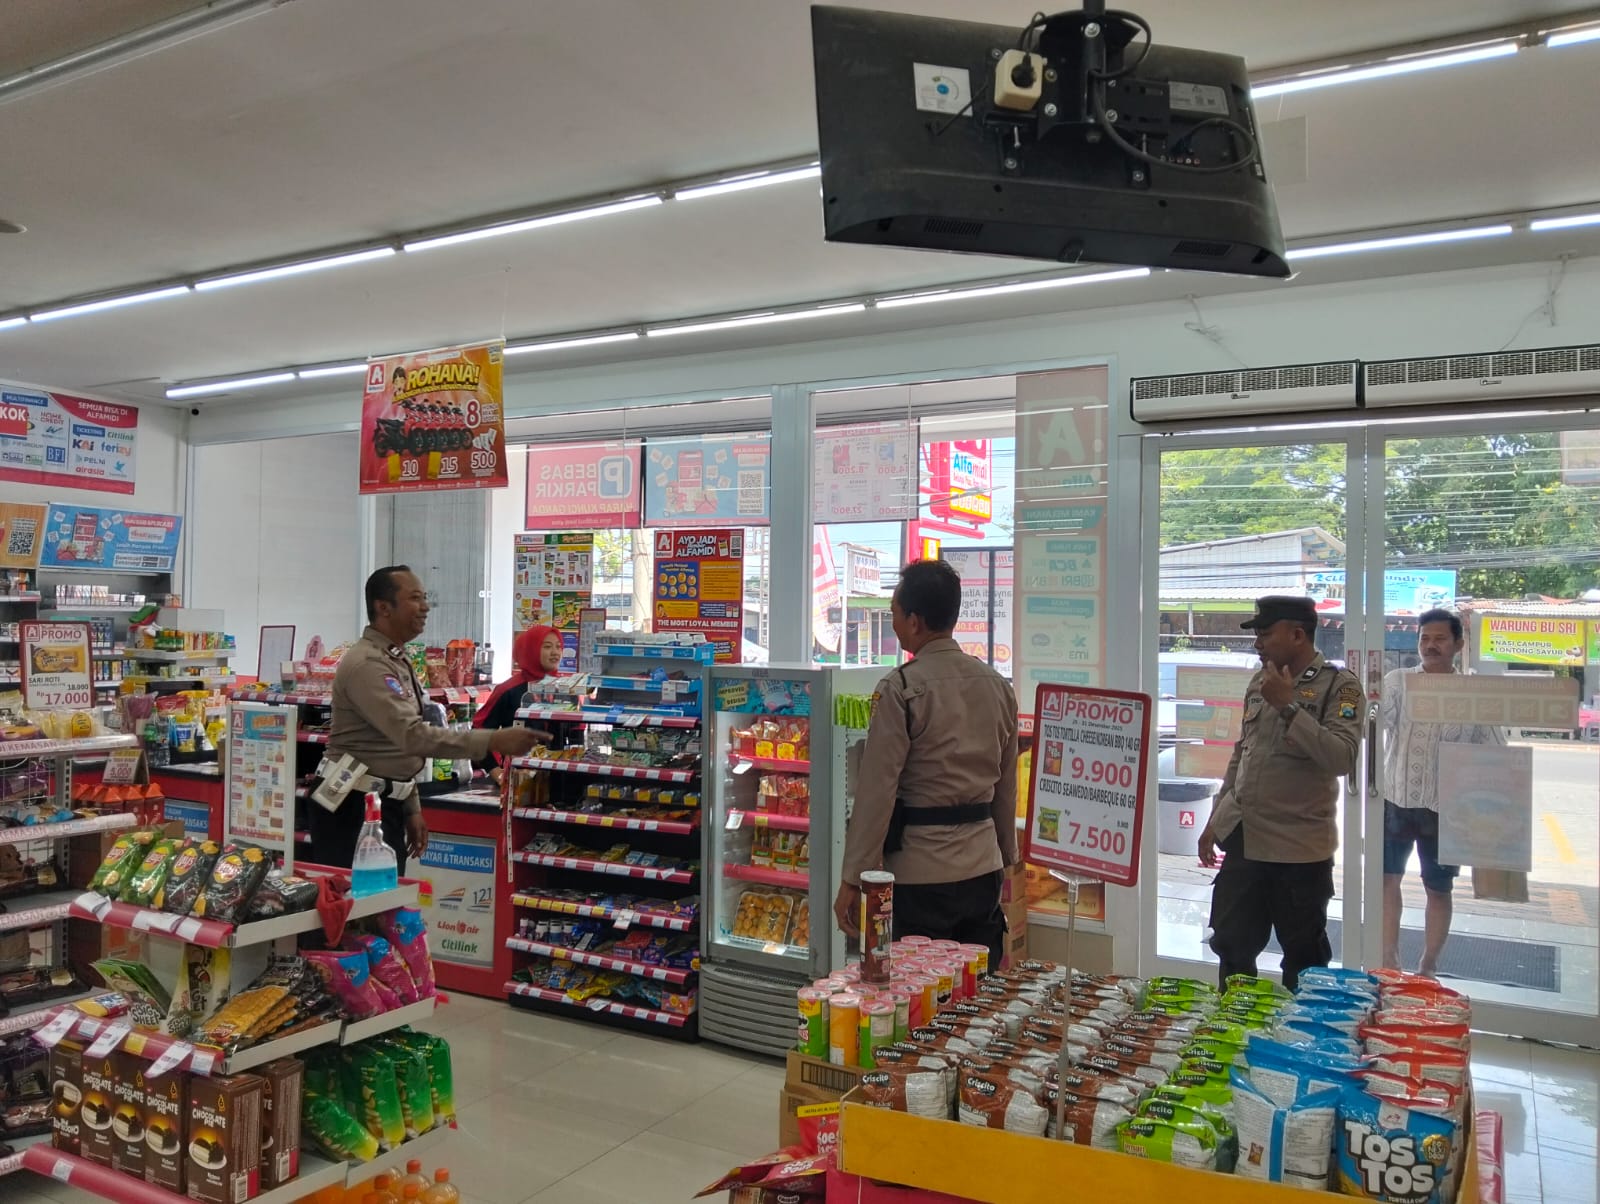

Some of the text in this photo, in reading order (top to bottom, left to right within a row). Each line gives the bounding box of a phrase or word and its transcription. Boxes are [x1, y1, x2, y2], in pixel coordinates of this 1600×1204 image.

[78, 402, 103, 412] SEMUA
[465, 399, 481, 429] 8
[86, 411, 119, 422] ALFAMIDI
[441, 457, 458, 474] 15
[471, 452, 497, 469] 500
[953, 453, 988, 481] Alfamidi
[402, 460, 419, 477] 10
[675, 546, 716, 558] ALFAMIDI
[690, 620, 709, 628] LOYAL
[711, 621, 739, 629] MEMBER
[1489, 619, 1577, 634] WARUNG BU SRI
[41, 630, 82, 639] PROMO
[1496, 647, 1534, 655] LONTONG
[45, 692, 89, 705] 17.000
[1064, 700, 1134, 724] PROMO
[9, 741, 57, 752] KEMASAN
[1114, 733, 1125, 752] BBQ
[1071, 757, 1132, 788] 9.900
[1040, 778, 1061, 796] CRISCITO
[1120, 794, 1127, 807] 60
[1068, 821, 1126, 855] 7.500
[449, 853, 492, 868] TRANSAKSI
[437, 920, 480, 935] Lion air
[441, 938, 478, 953] Citilink
[876, 1050, 902, 1058] Criscito
[1106, 1043, 1133, 1054] Criscito
[1092, 1056, 1118, 1066] Criscito
[83, 1073, 111, 1092] CHOCOLATE
[862, 1075, 889, 1084] Criscito
[967, 1077, 996, 1092] Criscito
[114, 1084, 144, 1104] CHOCOLATE
[146, 1095, 179, 1116] CHOCOLATE
[192, 1107, 227, 1128] CHOCOLATE
[1345, 1120, 1416, 1167] TOS
[1361, 1159, 1435, 1195] TOS
